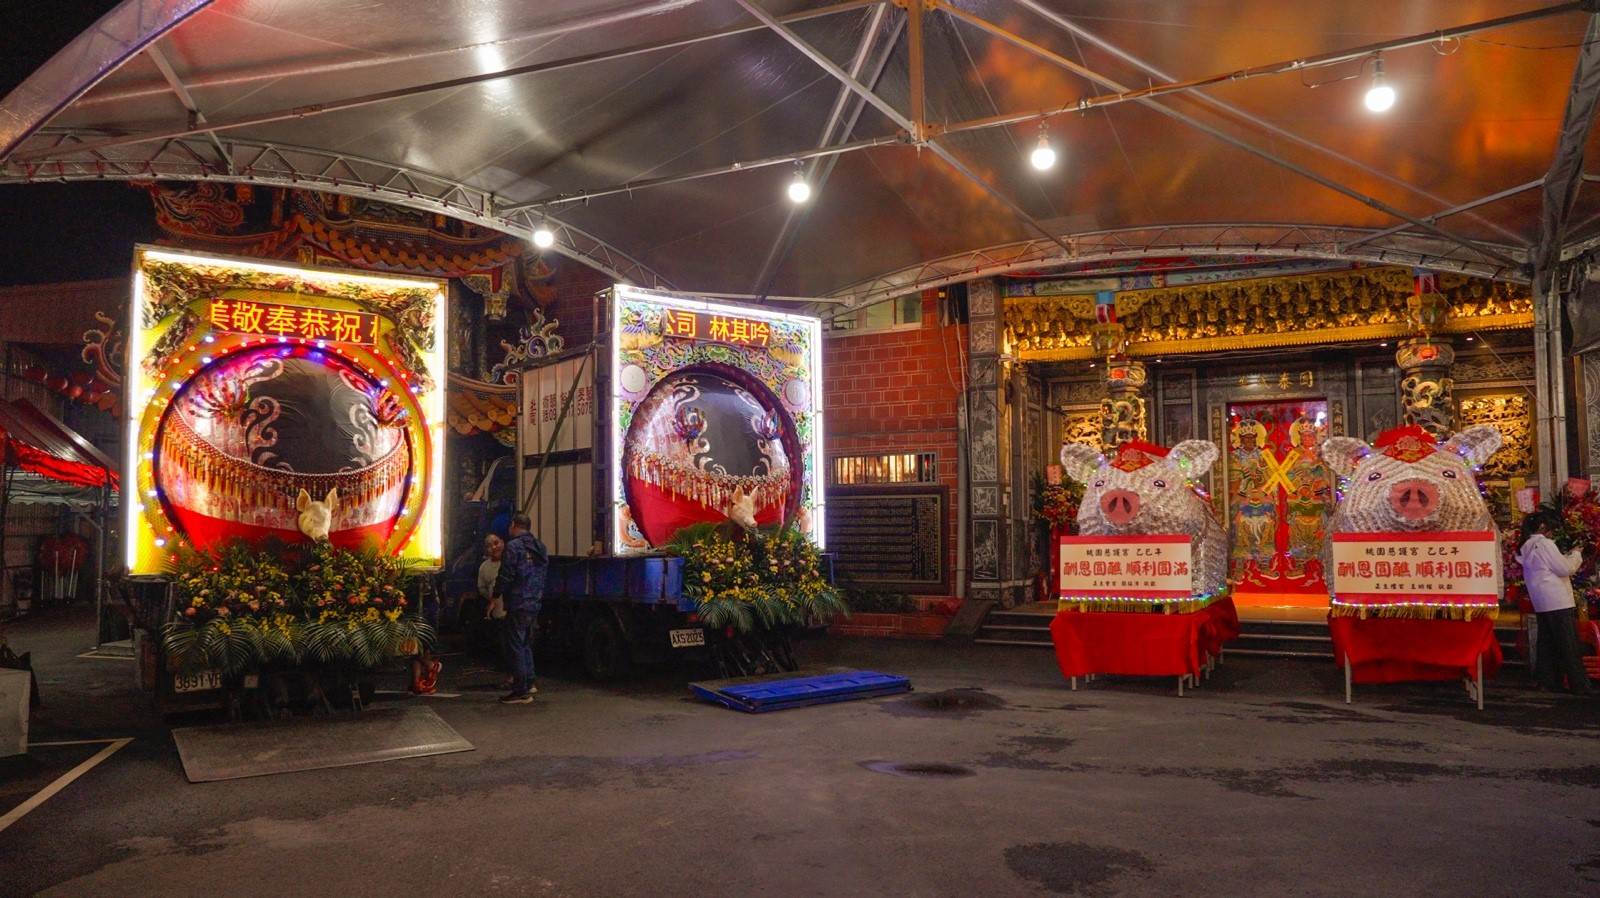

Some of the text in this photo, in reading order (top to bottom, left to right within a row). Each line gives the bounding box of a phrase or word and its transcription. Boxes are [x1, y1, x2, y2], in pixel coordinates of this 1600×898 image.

[1126, 561, 1188, 576] 順利圓滿
[1416, 561, 1493, 578] 順利圓滿
